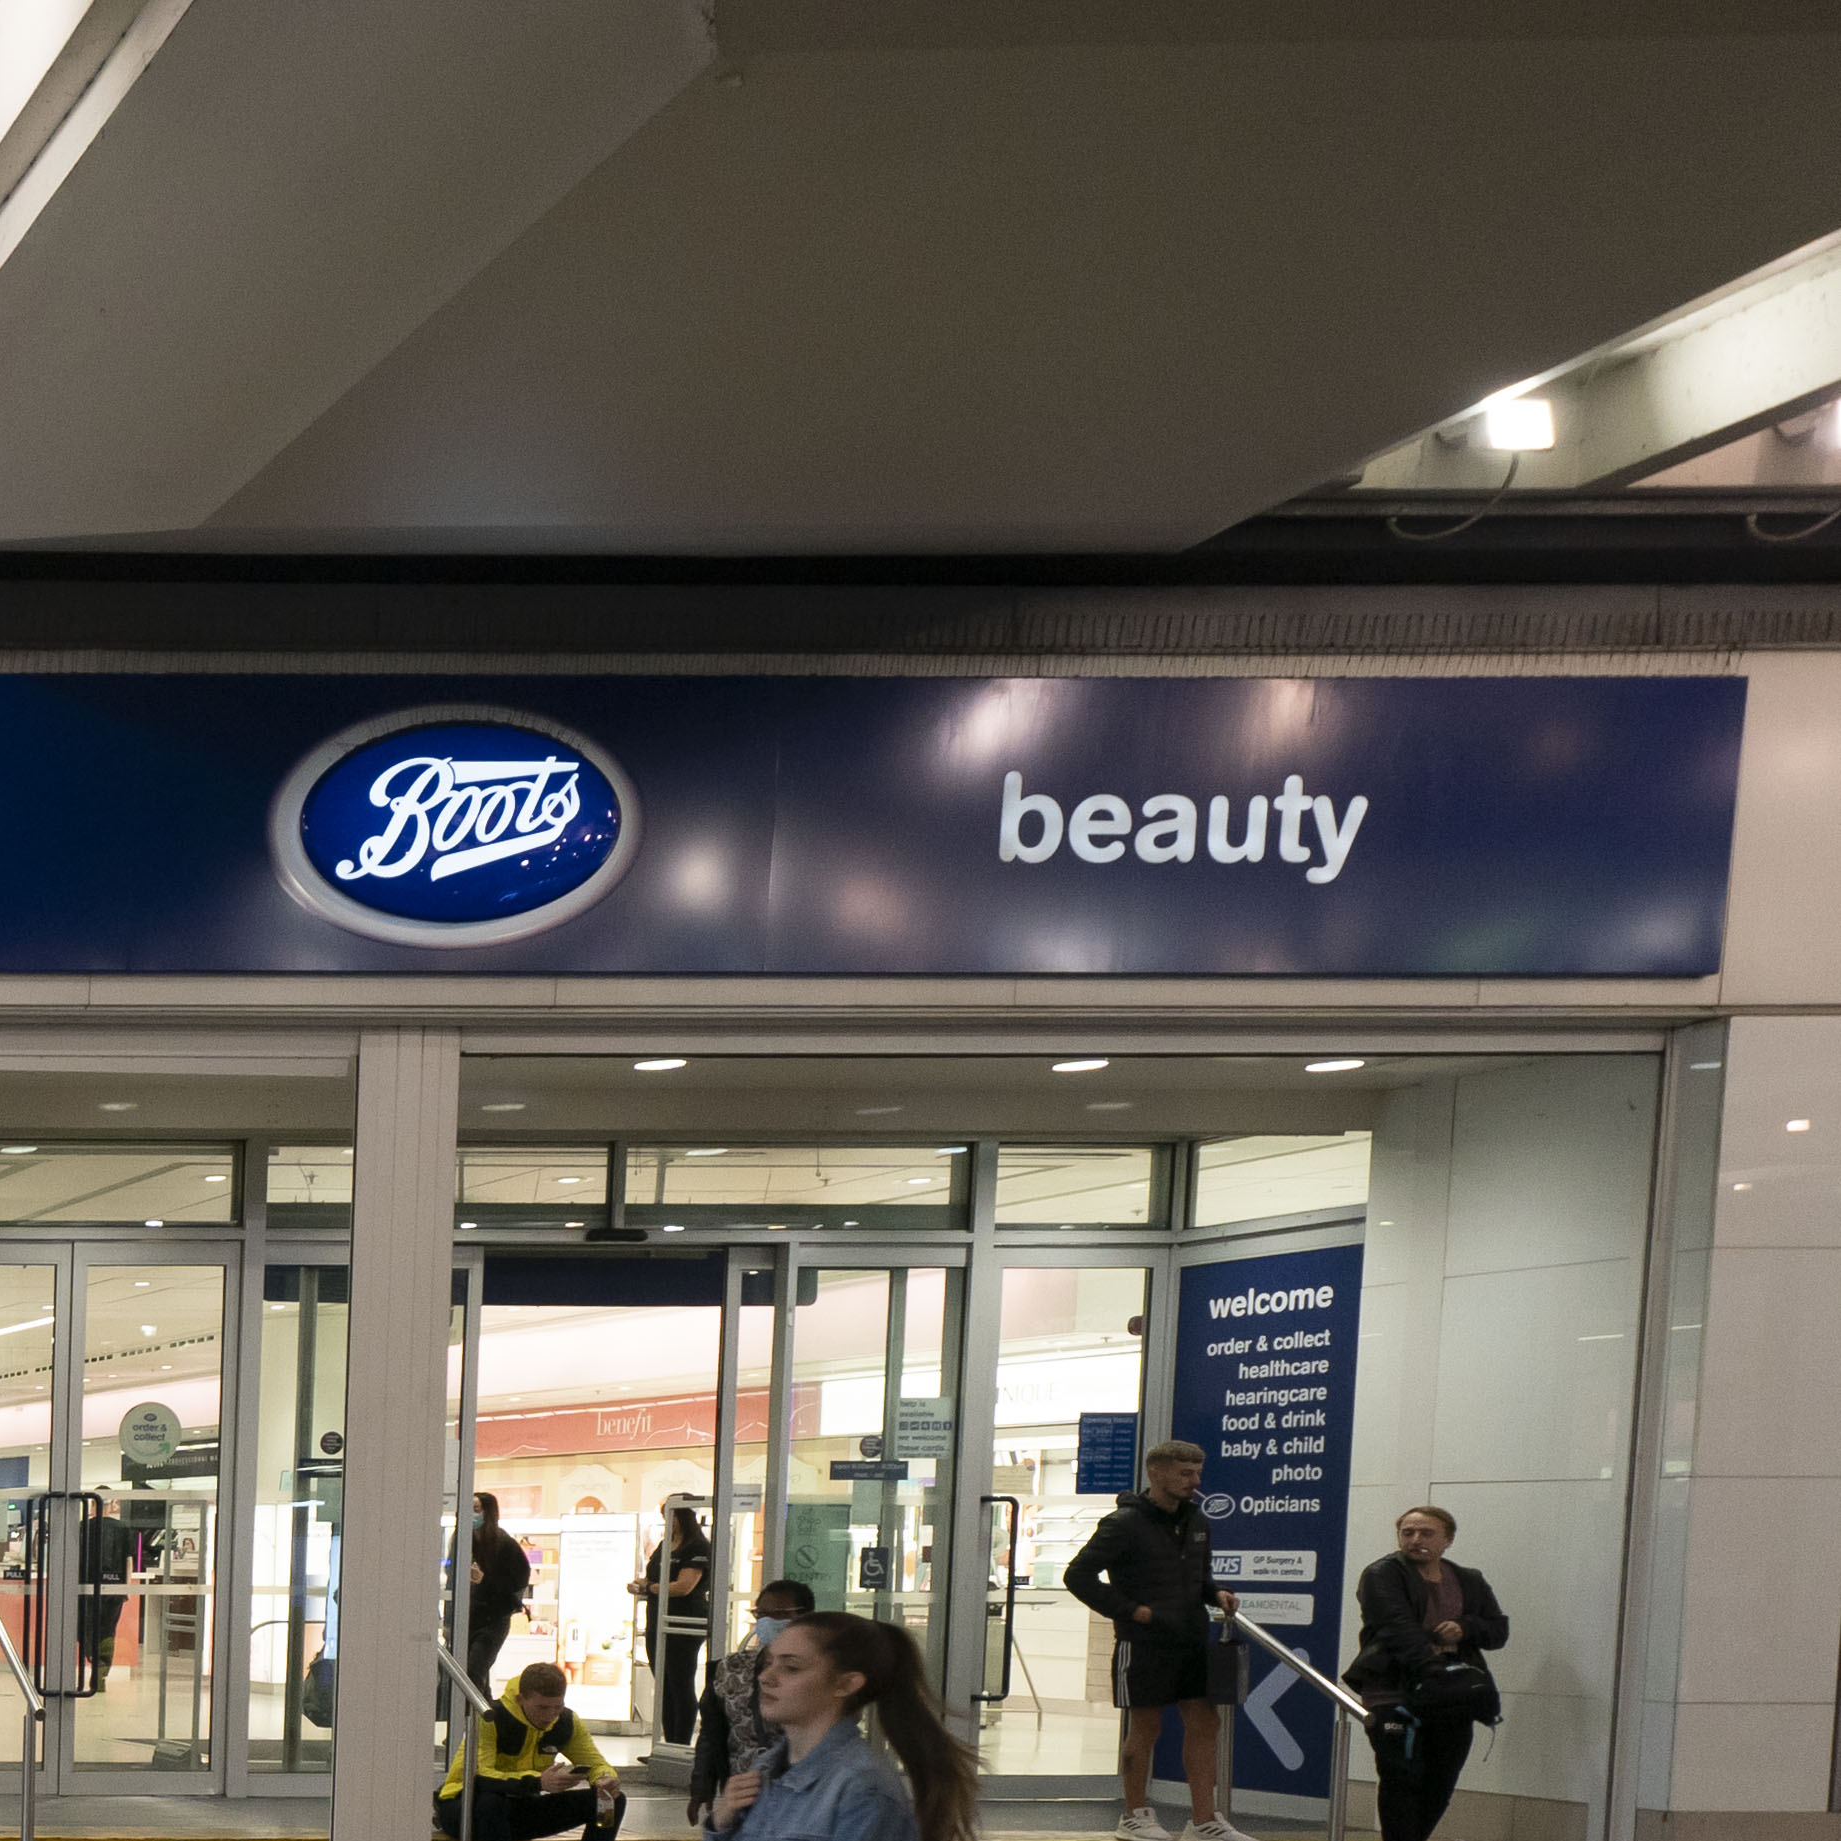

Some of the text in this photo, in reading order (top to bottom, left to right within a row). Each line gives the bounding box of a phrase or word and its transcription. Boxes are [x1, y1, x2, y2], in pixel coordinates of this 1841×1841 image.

[335, 756, 580, 882] Boots
[999, 771, 1368, 884] beauty
[1209, 1285, 1334, 1319] welcome
[1206, 1329, 1331, 1356] order & collect
[1238, 1359, 1329, 1379] healthcare
[1225, 1386, 1327, 1407] hearingcare
[133, 1423, 158, 1431] order
[596, 1408, 653, 1440] benefit
[1222, 1409, 1325, 1431] food & drink
[133, 1433, 165, 1441] collect
[1221, 1436, 1324, 1459] baby & child
[1271, 1464, 1322, 1484] photo
[1240, 1495, 1320, 1515] Opticians
[1211, 1557, 1239, 1573] NHS
[1267, 1556, 1295, 1566] Surgery
